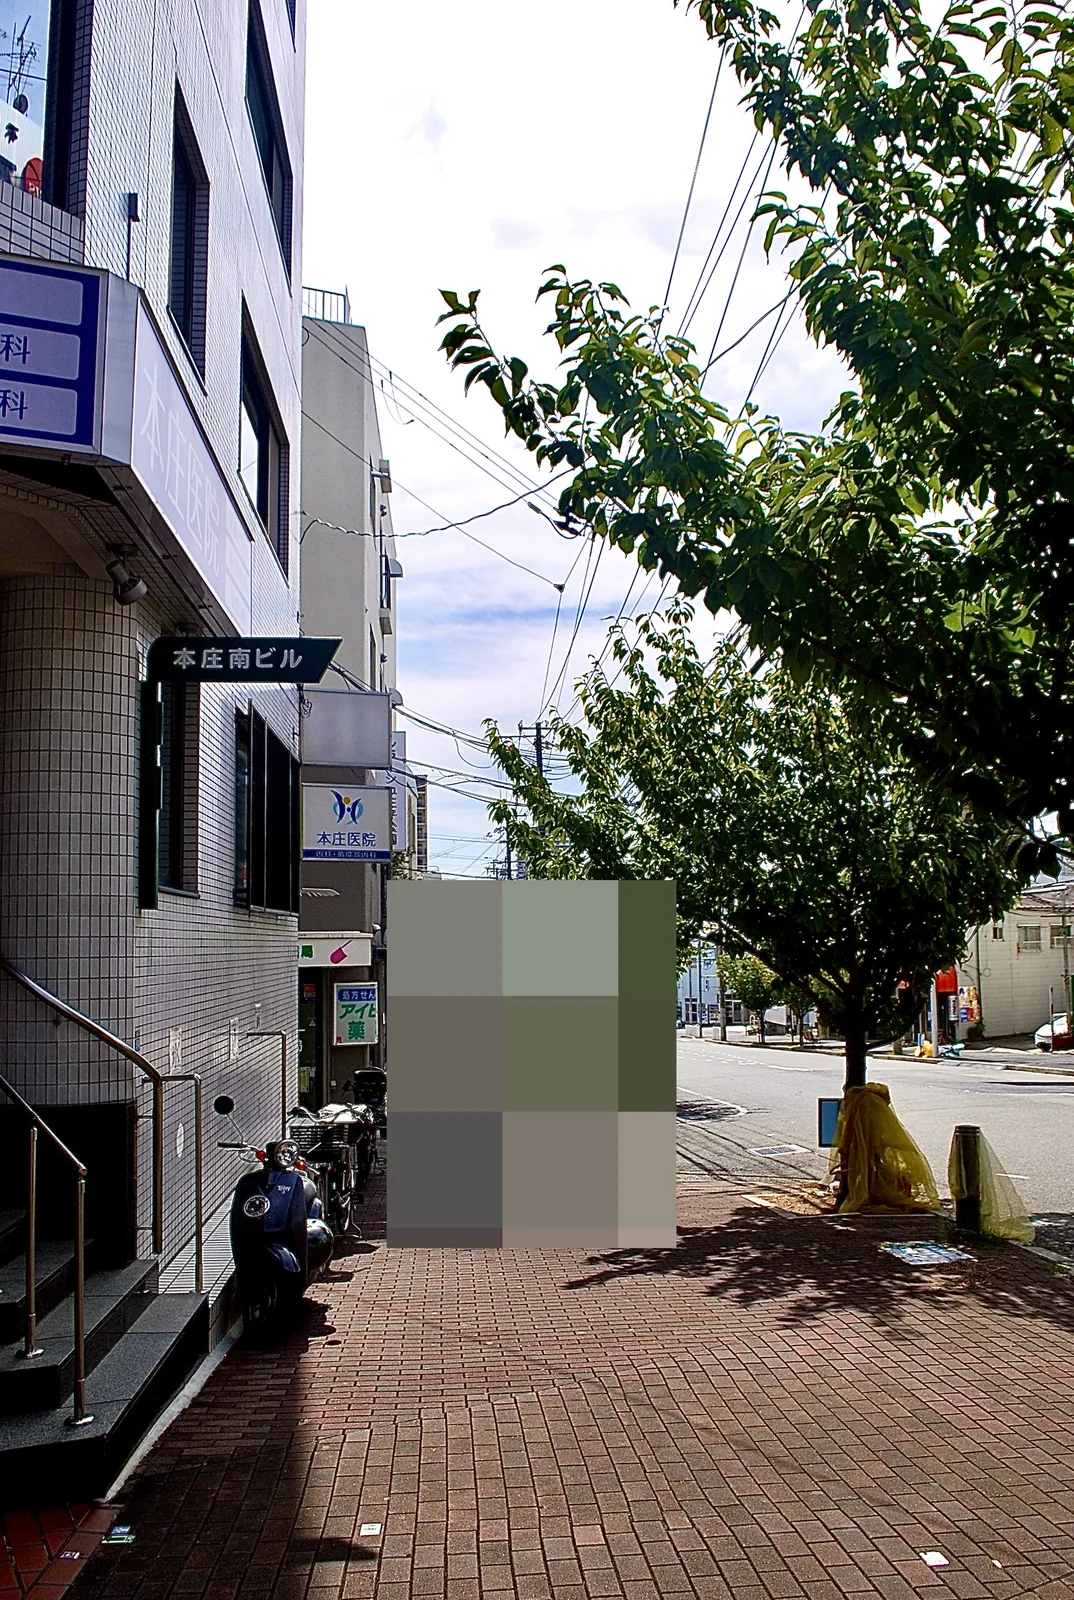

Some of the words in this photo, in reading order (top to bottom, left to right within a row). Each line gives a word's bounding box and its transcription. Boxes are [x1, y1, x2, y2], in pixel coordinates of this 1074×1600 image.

[0, 333, 31, 364] 科
[140, 364, 220, 578] 本庄医院
[172, 646, 303, 670] 本庄南ビル
[316, 830, 377, 847] 本庄医院
